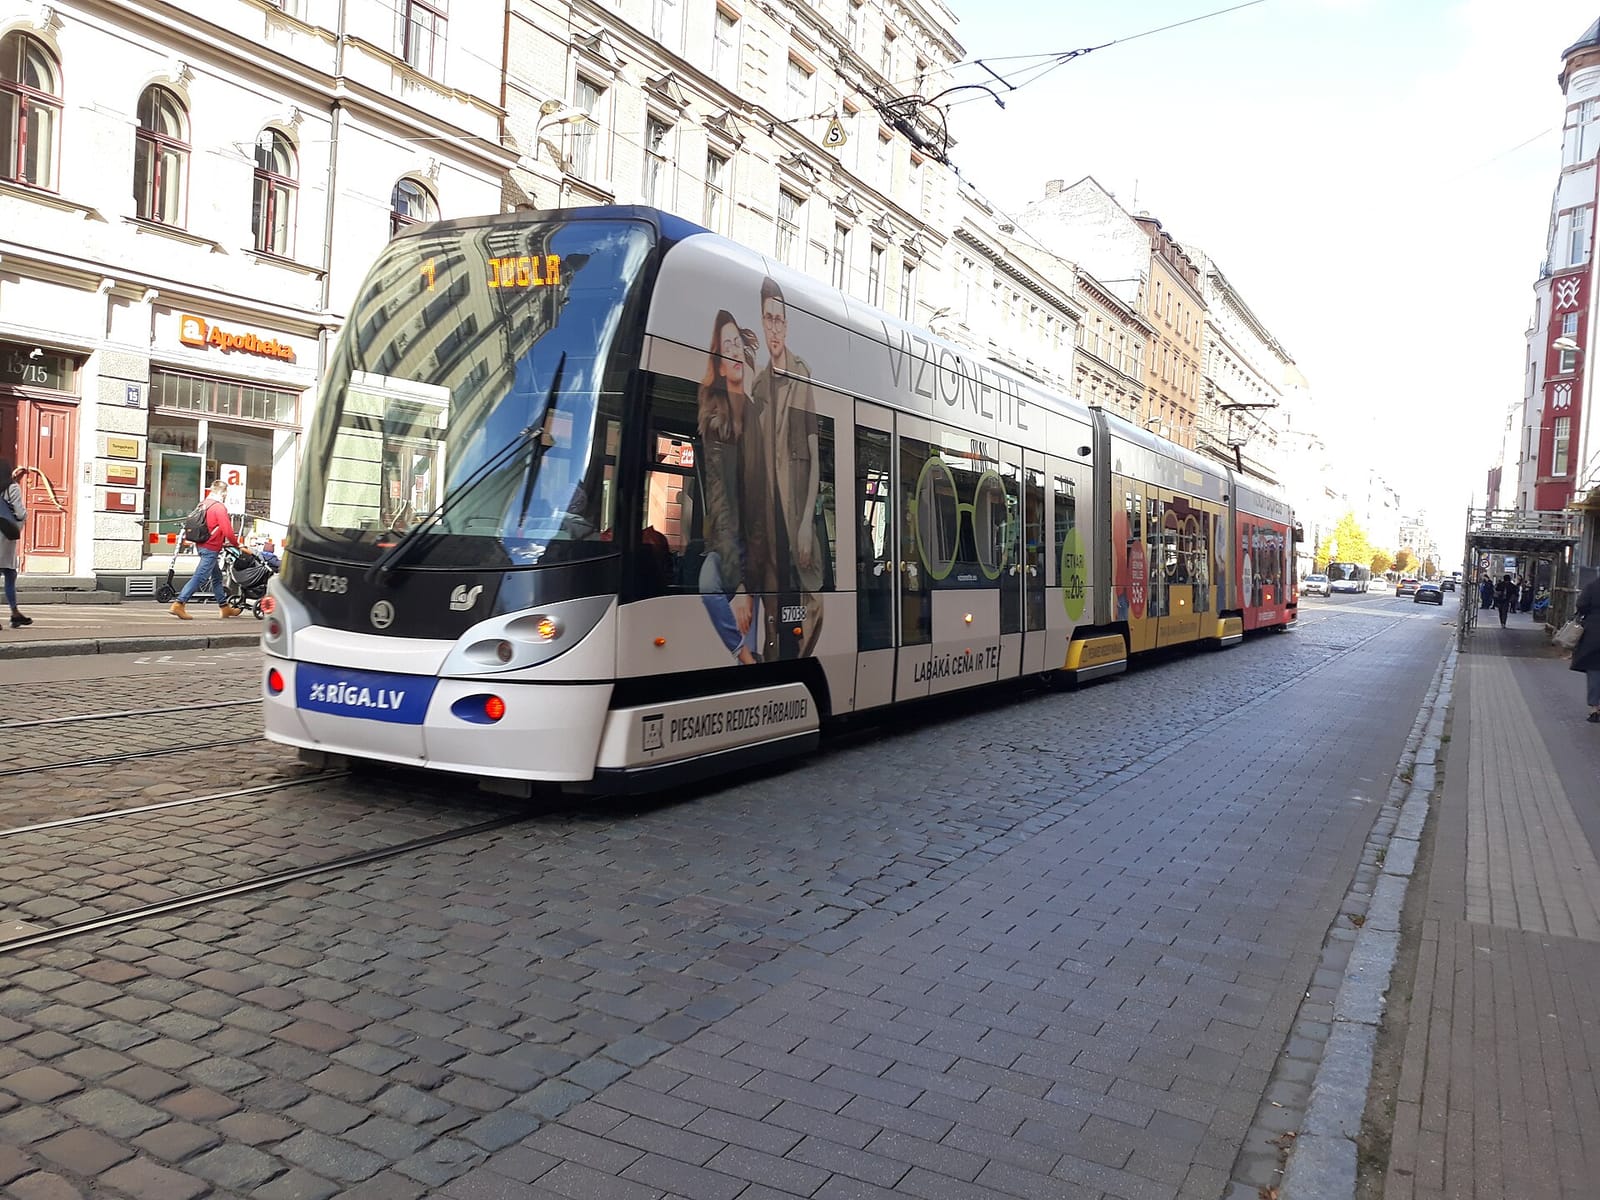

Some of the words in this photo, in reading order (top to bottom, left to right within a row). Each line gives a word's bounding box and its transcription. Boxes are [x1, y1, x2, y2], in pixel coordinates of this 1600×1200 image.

[830, 127, 839, 142] S
[487, 254, 561, 288] JUGLA
[208, 325, 295, 359] Apotheka
[880, 319, 1028, 431] VIZIONETTE
[306, 572, 348, 594] 57038
[783, 606, 807, 621] 57038
[914, 653, 950, 683] LABĀKĀ
[952, 654, 974, 676] CENA
[975, 651, 984, 672] IR
[326, 681, 405, 710] RĪGA.LV
[671, 711, 724, 743] PIESAKIES
[726, 704, 760, 732] REDZES
